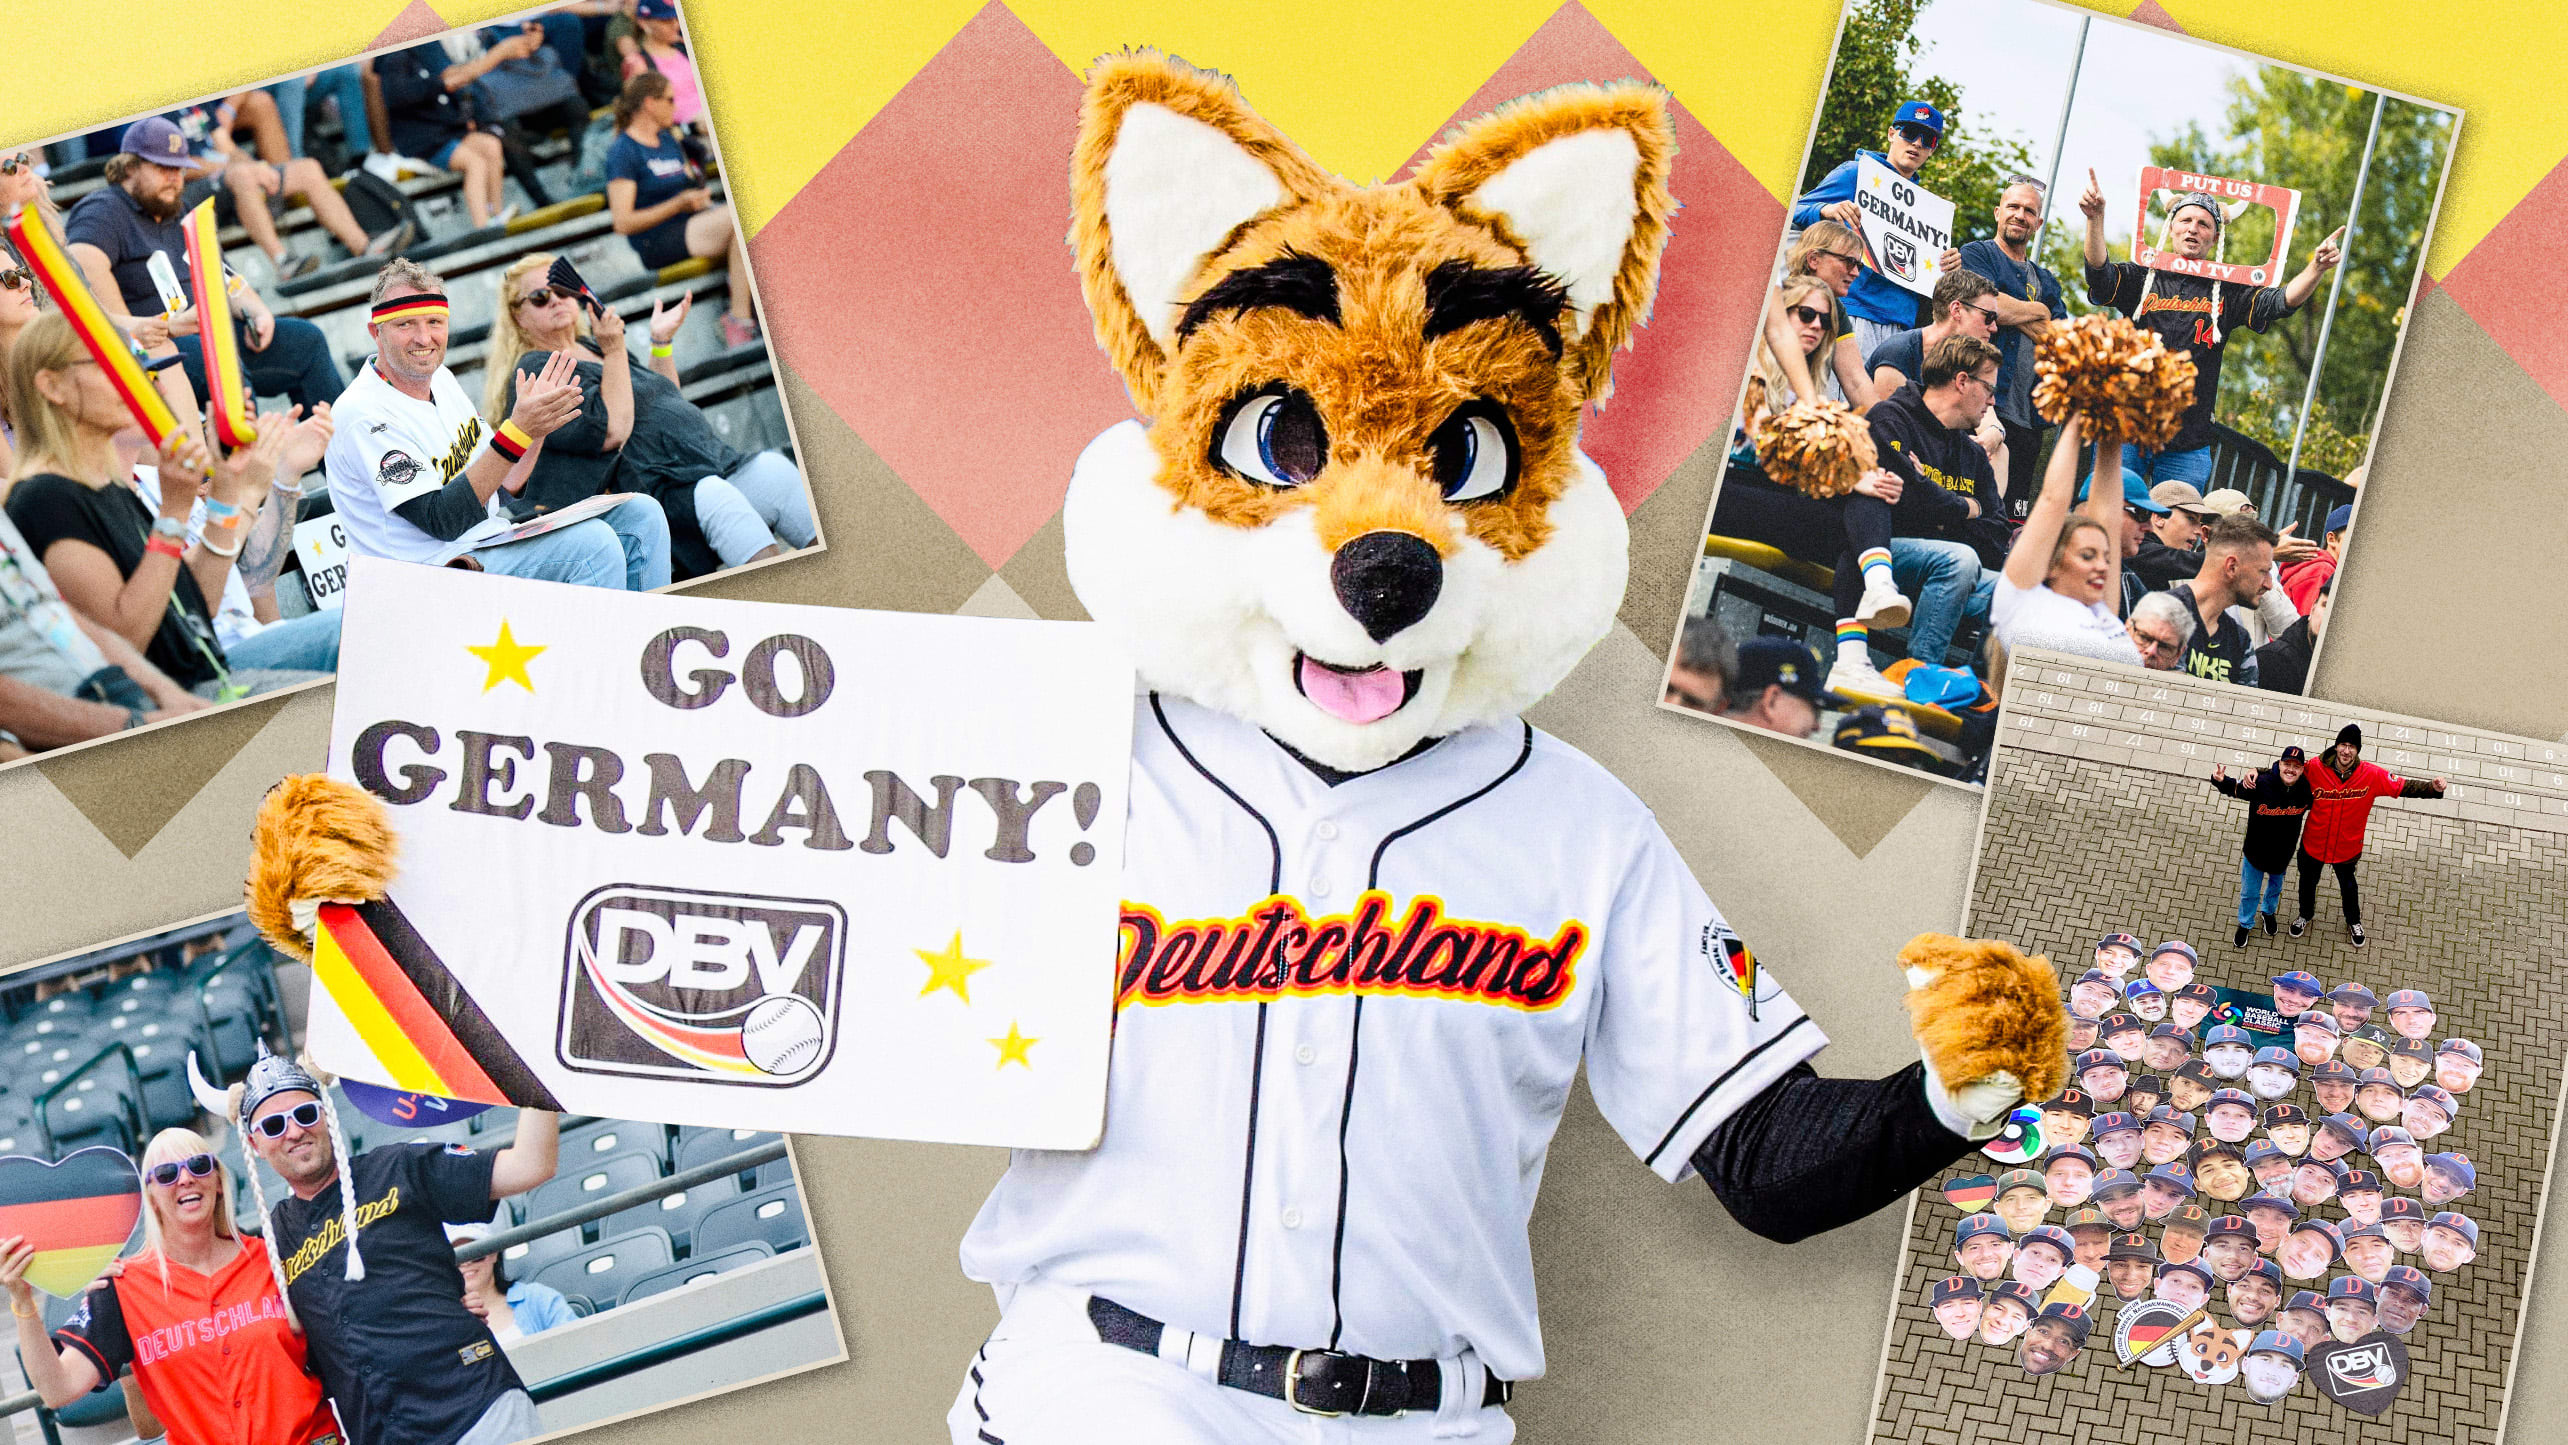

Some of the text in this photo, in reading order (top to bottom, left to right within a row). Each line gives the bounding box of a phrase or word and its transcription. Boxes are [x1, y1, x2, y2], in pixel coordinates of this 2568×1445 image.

[2180, 174, 2253, 197] PUT US
[1892, 182, 1915, 207] GO
[1858, 190, 1948, 251] GERMANY!
[1887, 239, 1914, 262] DBV
[2173, 258, 2236, 279] ON TV
[2194, 319, 2213, 349] 14
[330, 523, 345, 549] G
[311, 562, 347, 598] GER
[639, 625, 836, 719] GO
[351, 720, 1104, 868] GERMANY!
[2118, 933, 2131, 944] D
[2172, 940, 2186, 950] D
[595, 906, 825, 996] DBV
[2294, 971, 2310, 980] D
[2192, 985, 2207, 995] D
[2347, 982, 2362, 991] D
[2400, 991, 2414, 1003] D
[2244, 1011, 2289, 1025] BASEBALL
[2246, 1006, 2279, 1017] WORLD
[2310, 1011, 2324, 1022] D
[2111, 1015, 2125, 1027] D
[2243, 1017, 2281, 1029] CLASSIC
[2222, 1024, 2237, 1038] D
[2408, 1039, 2423, 1050] D
[2453, 1039, 2467, 1050] D
[2089, 1051, 2104, 1063] D
[2272, 1047, 2287, 1059] D
[2327, 1060, 2343, 1073] D
[2372, 1067, 2388, 1079] D
[2062, 1090, 2081, 1103] D
[2226, 1088, 2241, 1099] D
[2432, 1090, 2448, 1102] D
[2276, 1104, 2291, 1117] D
[2106, 1114, 2122, 1126] D
[2346, 1116, 2364, 1130] D
[2379, 1128, 2393, 1141] D
[2200, 1138, 2218, 1151] D
[2256, 1139, 2271, 1150] D
[2450, 1153, 2469, 1165] D
[2102, 1167, 2118, 1182] D
[2168, 1162, 2187, 1176] D
[2013, 1170, 2028, 1183] D
[2348, 1171, 2363, 1184] D
[2393, 1198, 2408, 1212] D
[2079, 1209, 2096, 1223] D
[2182, 1206, 2202, 1220] D
[1972, 1215, 1989, 1231] D
[2224, 1216, 2242, 1230] D
[2448, 1214, 2465, 1226] D
[2046, 1227, 2063, 1240] D
[2324, 1224, 2341, 1237] D
[2125, 1233, 2145, 1247] D
[2403, 1268, 2420, 1281] D
[1947, 1277, 1964, 1292] D
[2013, 1283, 2032, 1297] D
[2345, 1278, 2363, 1294] D
[2060, 1303, 2083, 1319] D
[137, 1295, 288, 1366] DEUTSCHLAN
[2273, 1332, 2291, 1347] D
[2330, 1347, 2384, 1373] DBV
